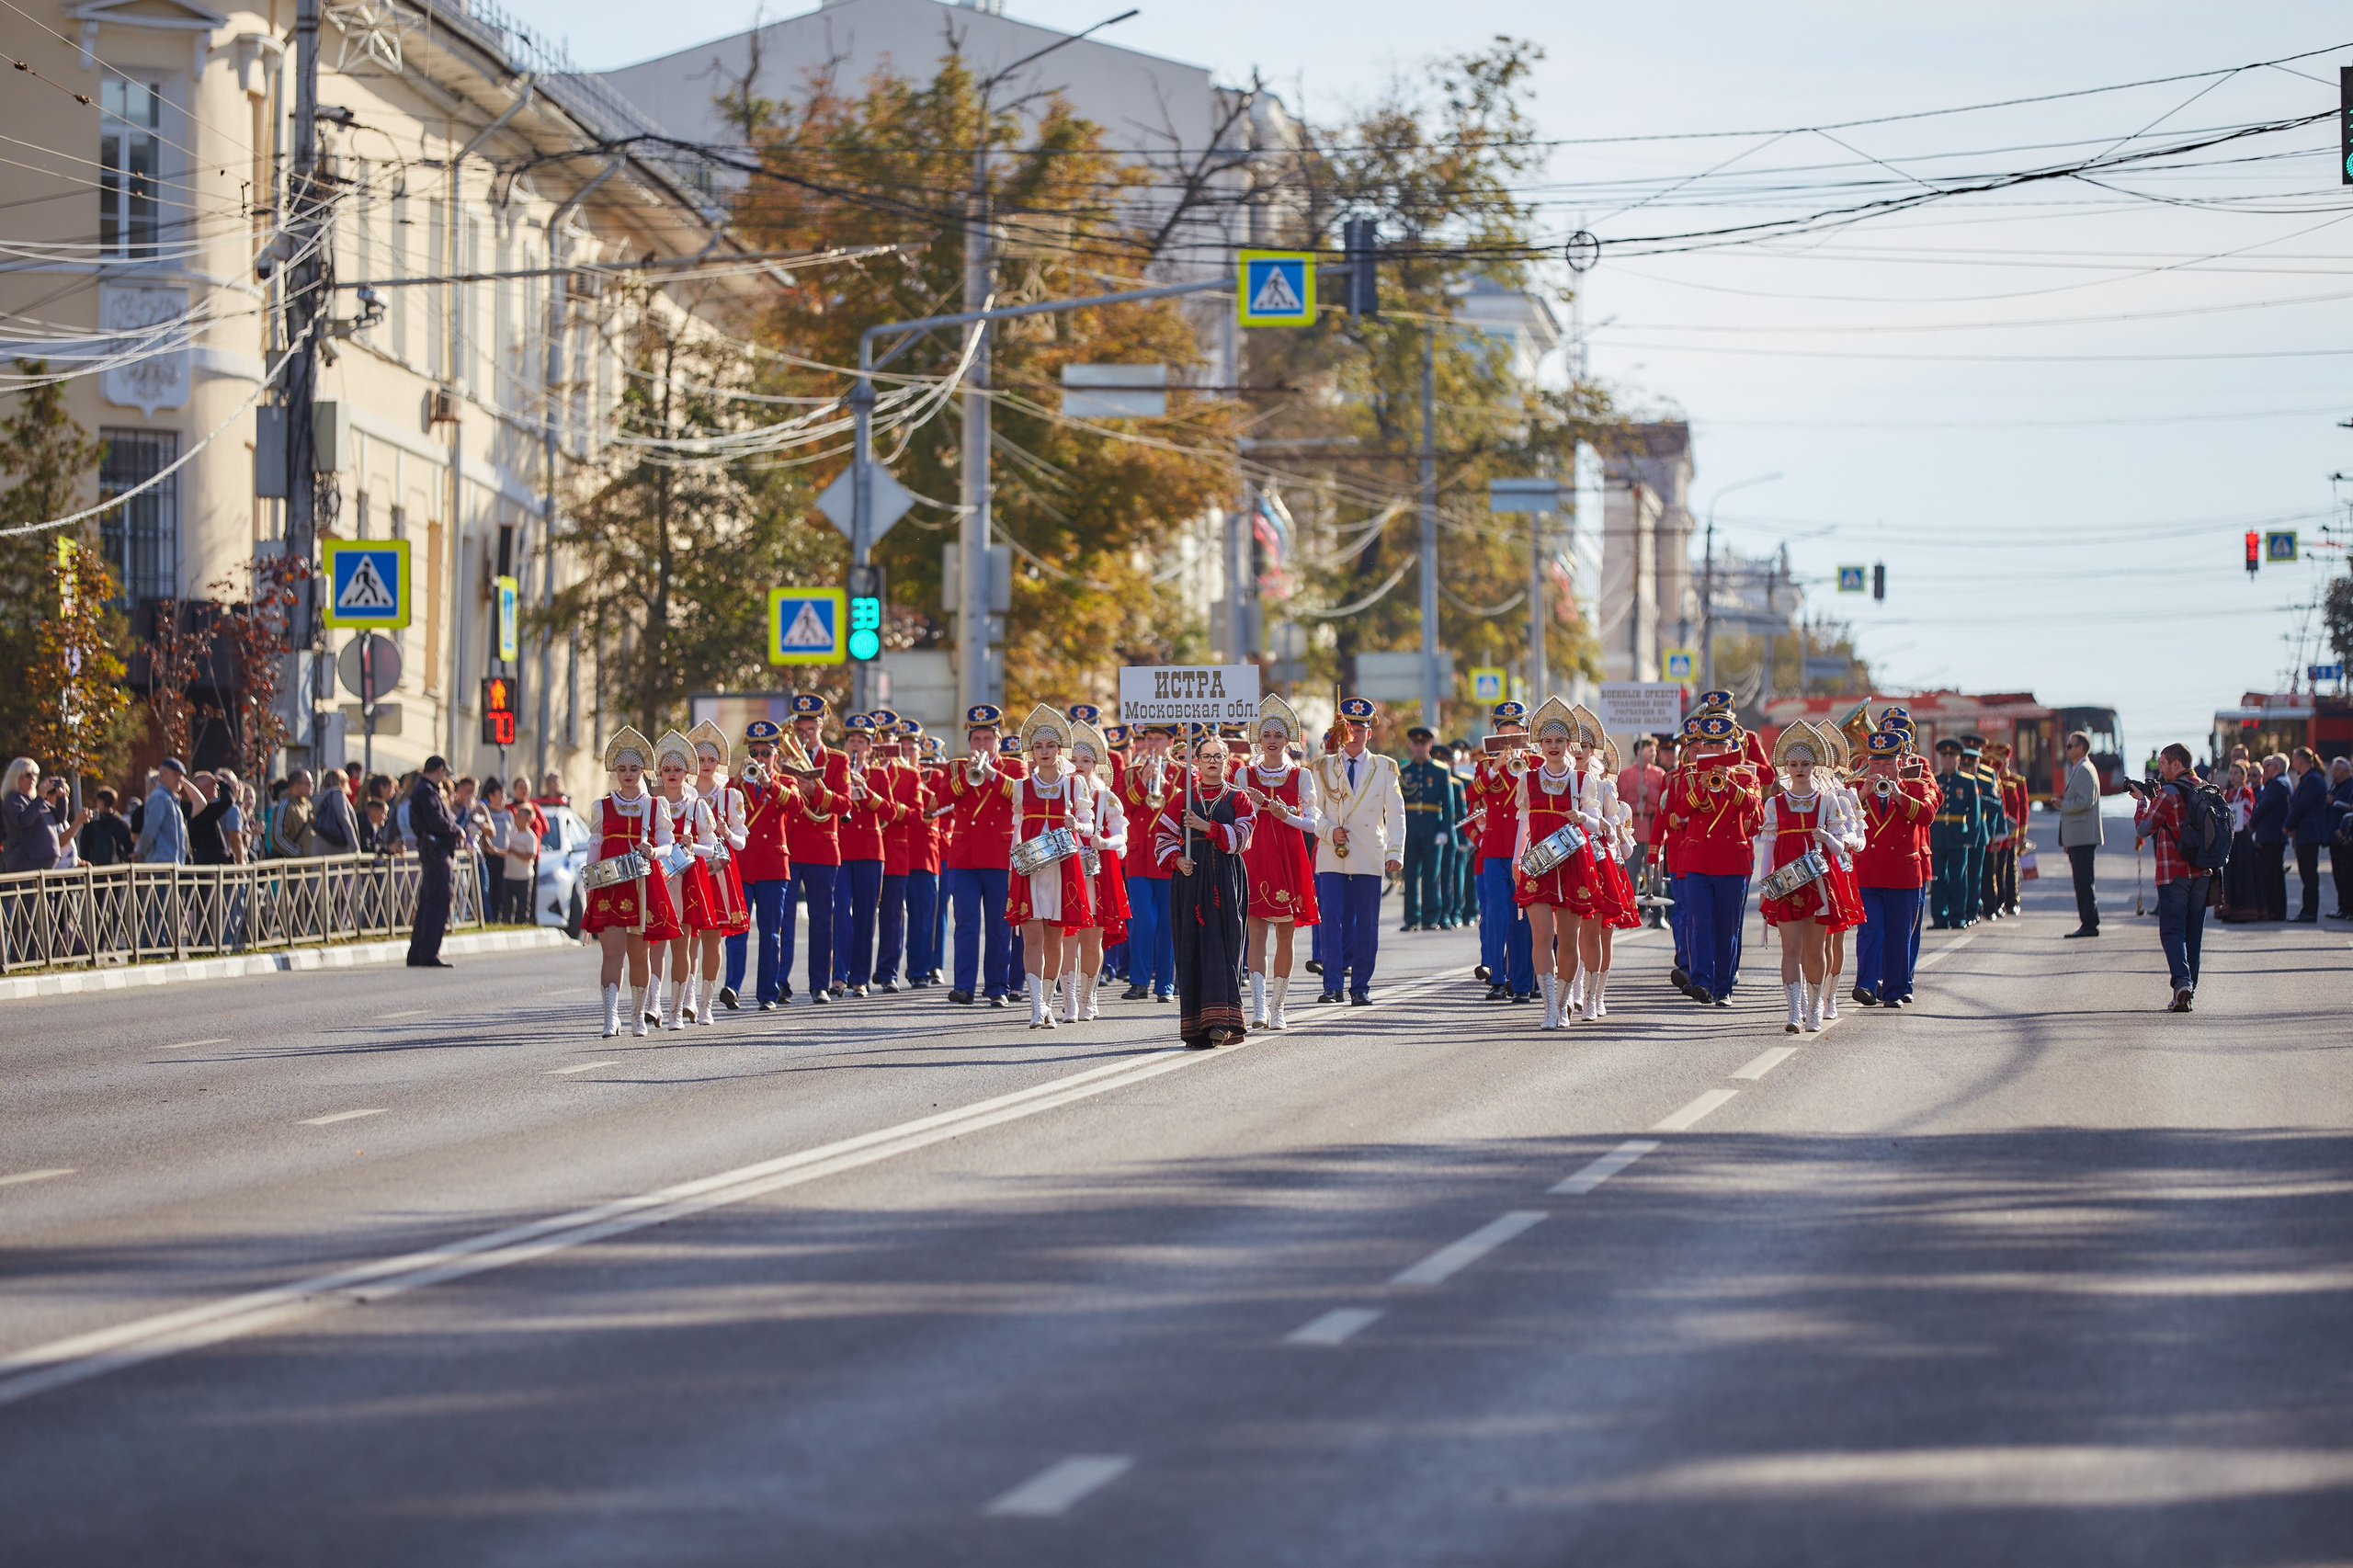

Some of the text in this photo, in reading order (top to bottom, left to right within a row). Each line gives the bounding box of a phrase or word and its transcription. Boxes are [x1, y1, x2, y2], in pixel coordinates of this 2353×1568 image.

[1154, 670, 1226, 699] ИСТРА
[1124, 699, 1258, 720] Московская обл.
[488, 711, 514, 744] 70
